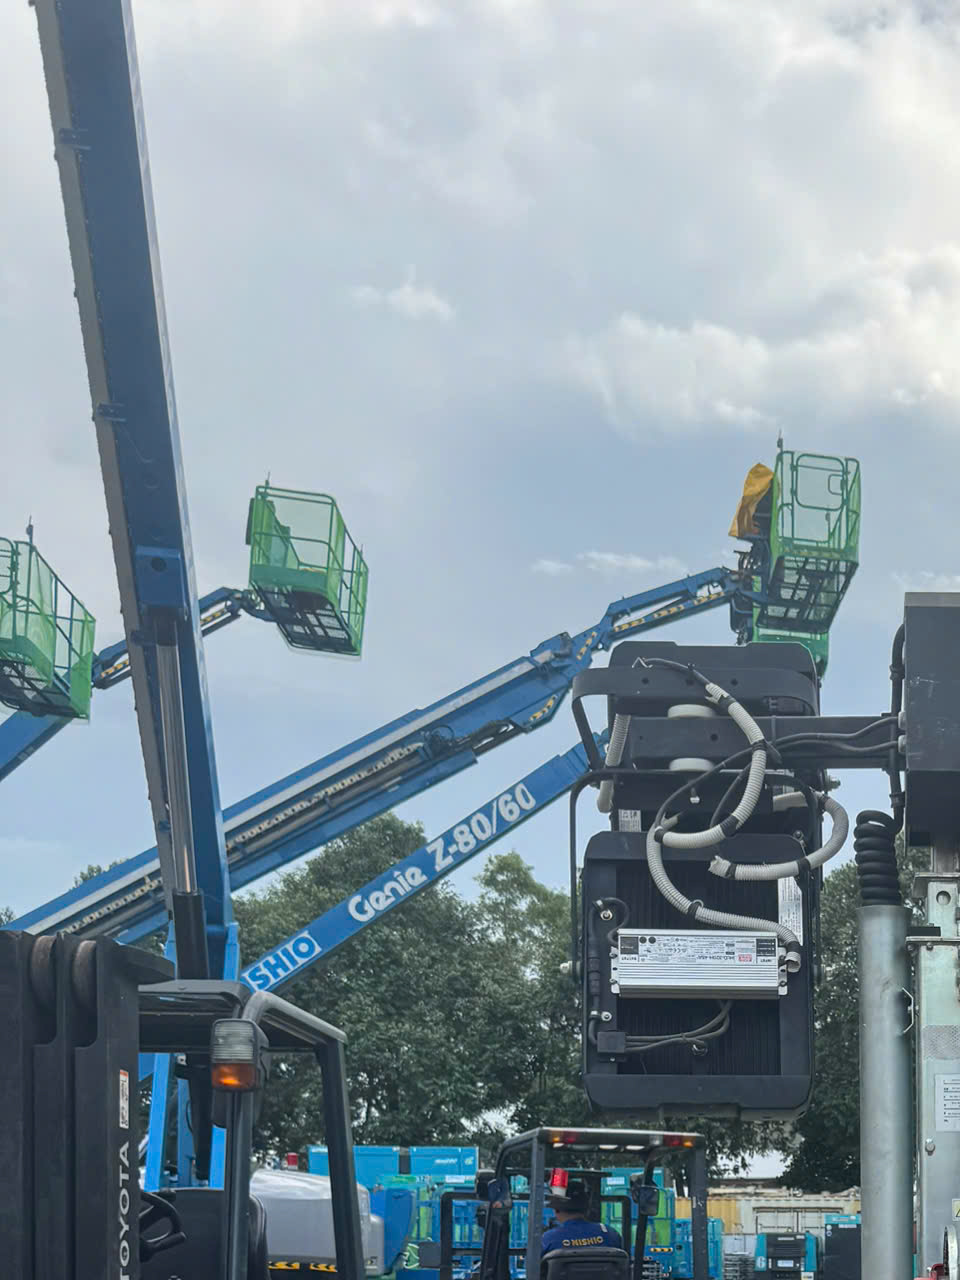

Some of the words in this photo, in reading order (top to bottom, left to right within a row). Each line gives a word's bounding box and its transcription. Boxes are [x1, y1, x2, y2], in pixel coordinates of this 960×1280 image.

[248, 936, 317, 990] SHIO
[348, 866, 428, 922] Genie
[426, 782, 536, 873] Z-80/60
